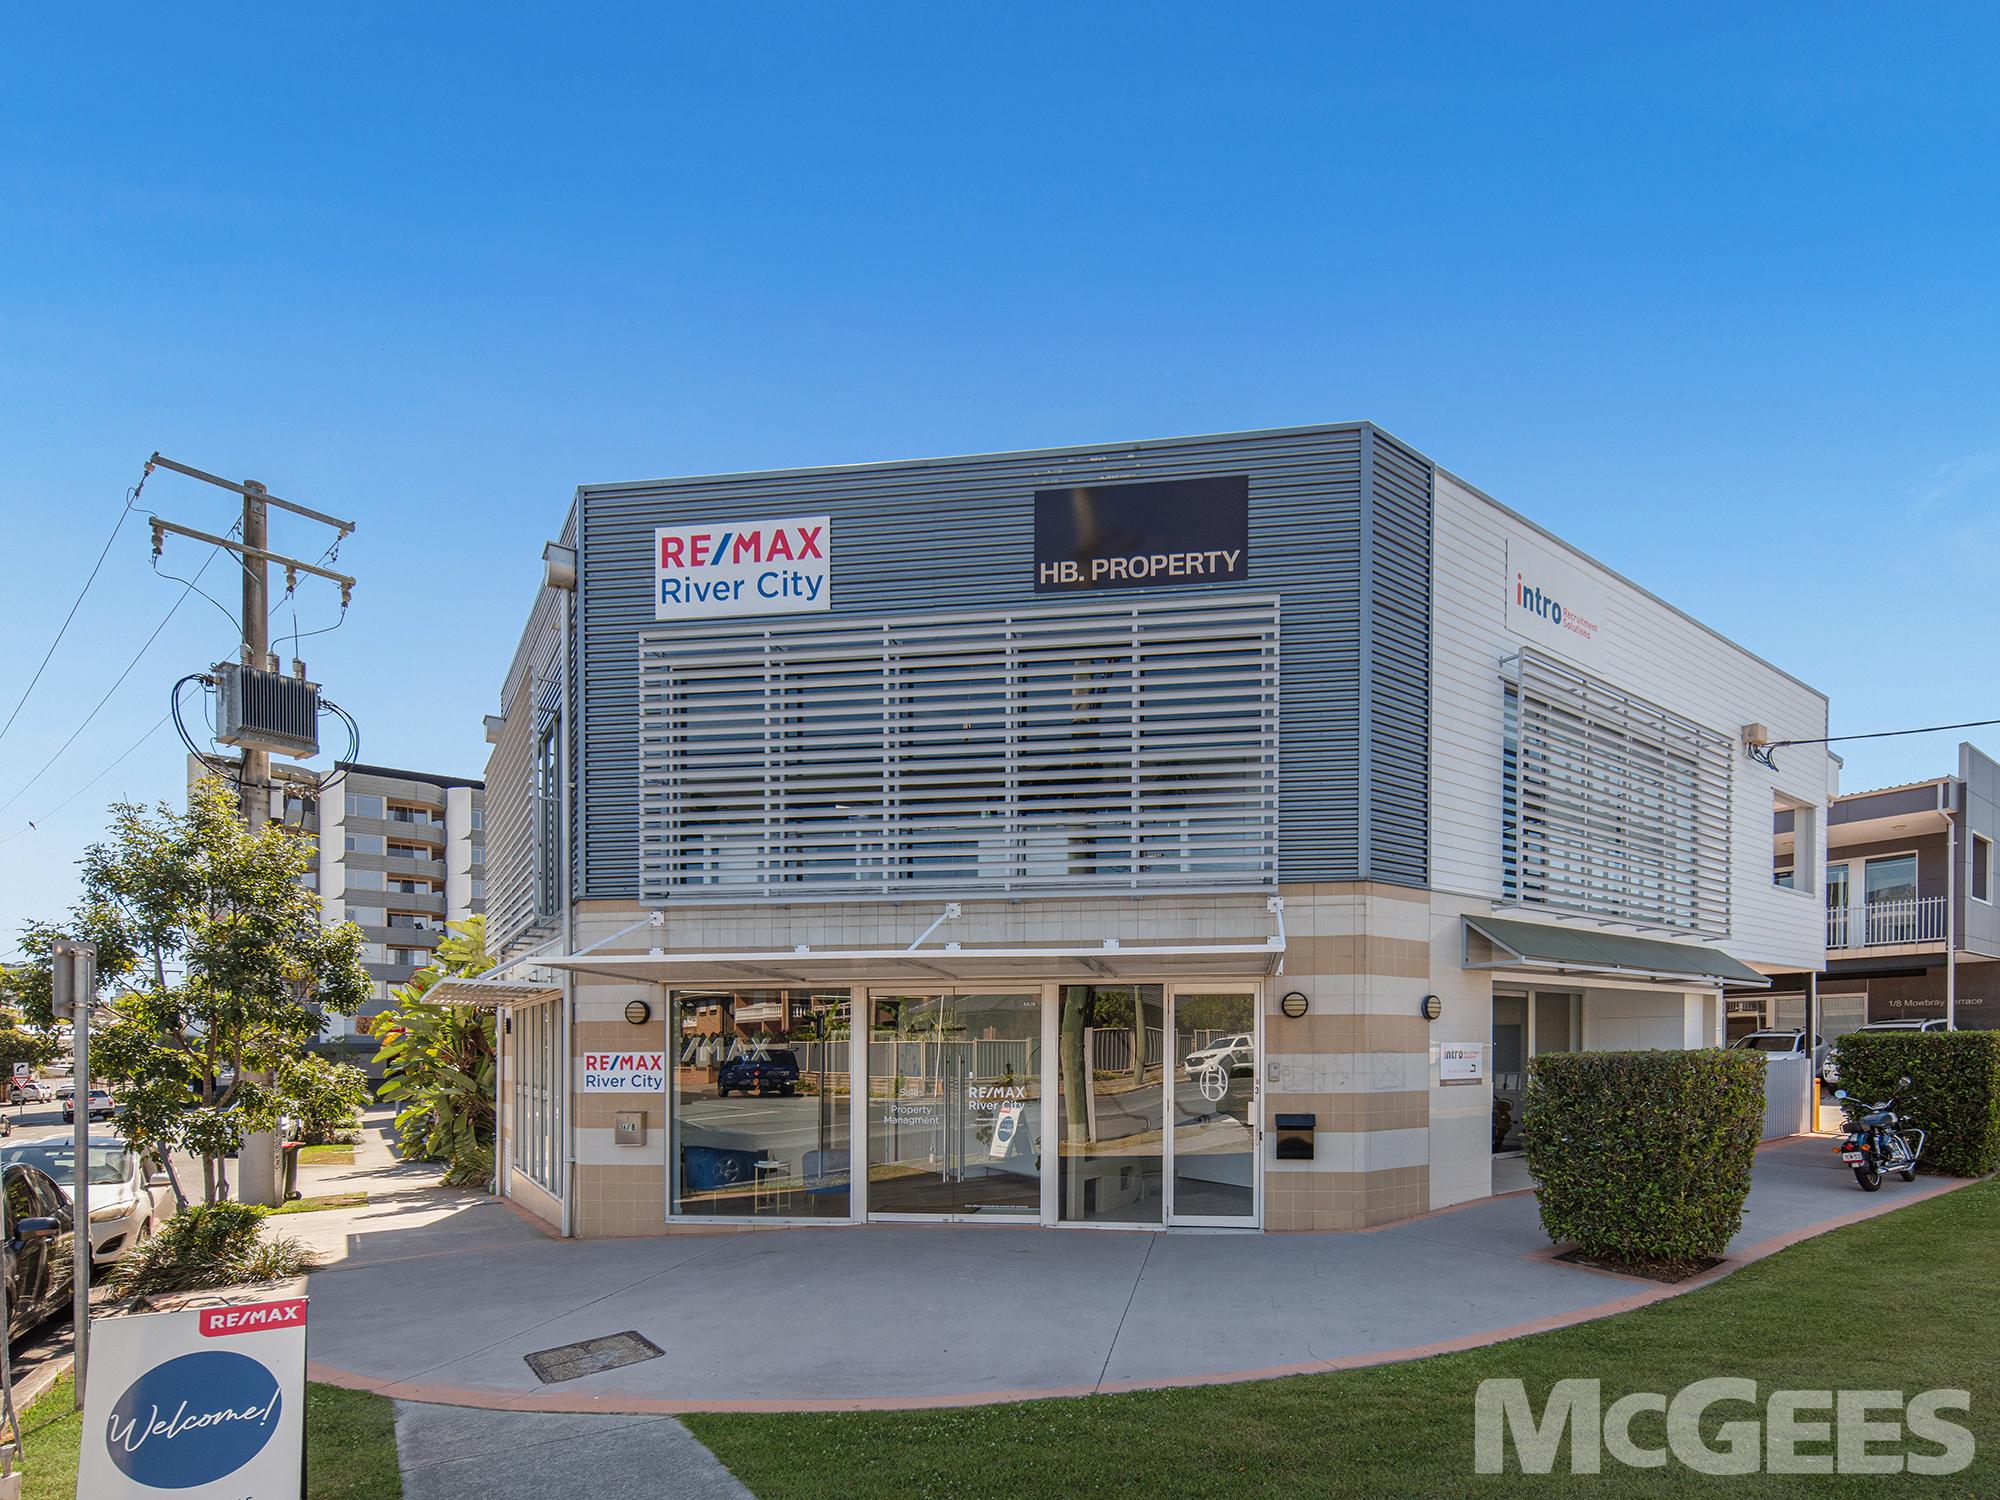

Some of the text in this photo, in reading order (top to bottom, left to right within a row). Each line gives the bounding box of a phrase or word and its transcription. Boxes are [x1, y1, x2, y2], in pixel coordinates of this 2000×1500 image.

[661, 527, 823, 569] RE/MAX
[1040, 550, 1240, 584] HB. PROPERTY
[661, 570, 823, 604] River City
[1517, 573, 1561, 624] intro
[1563, 607, 1598, 632] Recruitment
[1563, 618, 1591, 640] Solutions
[1904, 999, 1945, 1007] Mowbray
[586, 1055, 662, 1070] RE/MAX
[586, 1074, 663, 1090] River City
[900, 1088, 924, 1096] Sales
[968, 1086, 1025, 1098] RE/MAX
[891, 1105, 932, 1115] Property
[968, 1100, 1025, 1112] River City
[209, 1306, 298, 1329] RE/MAX
[110, 1386, 282, 1452] Welcome!
